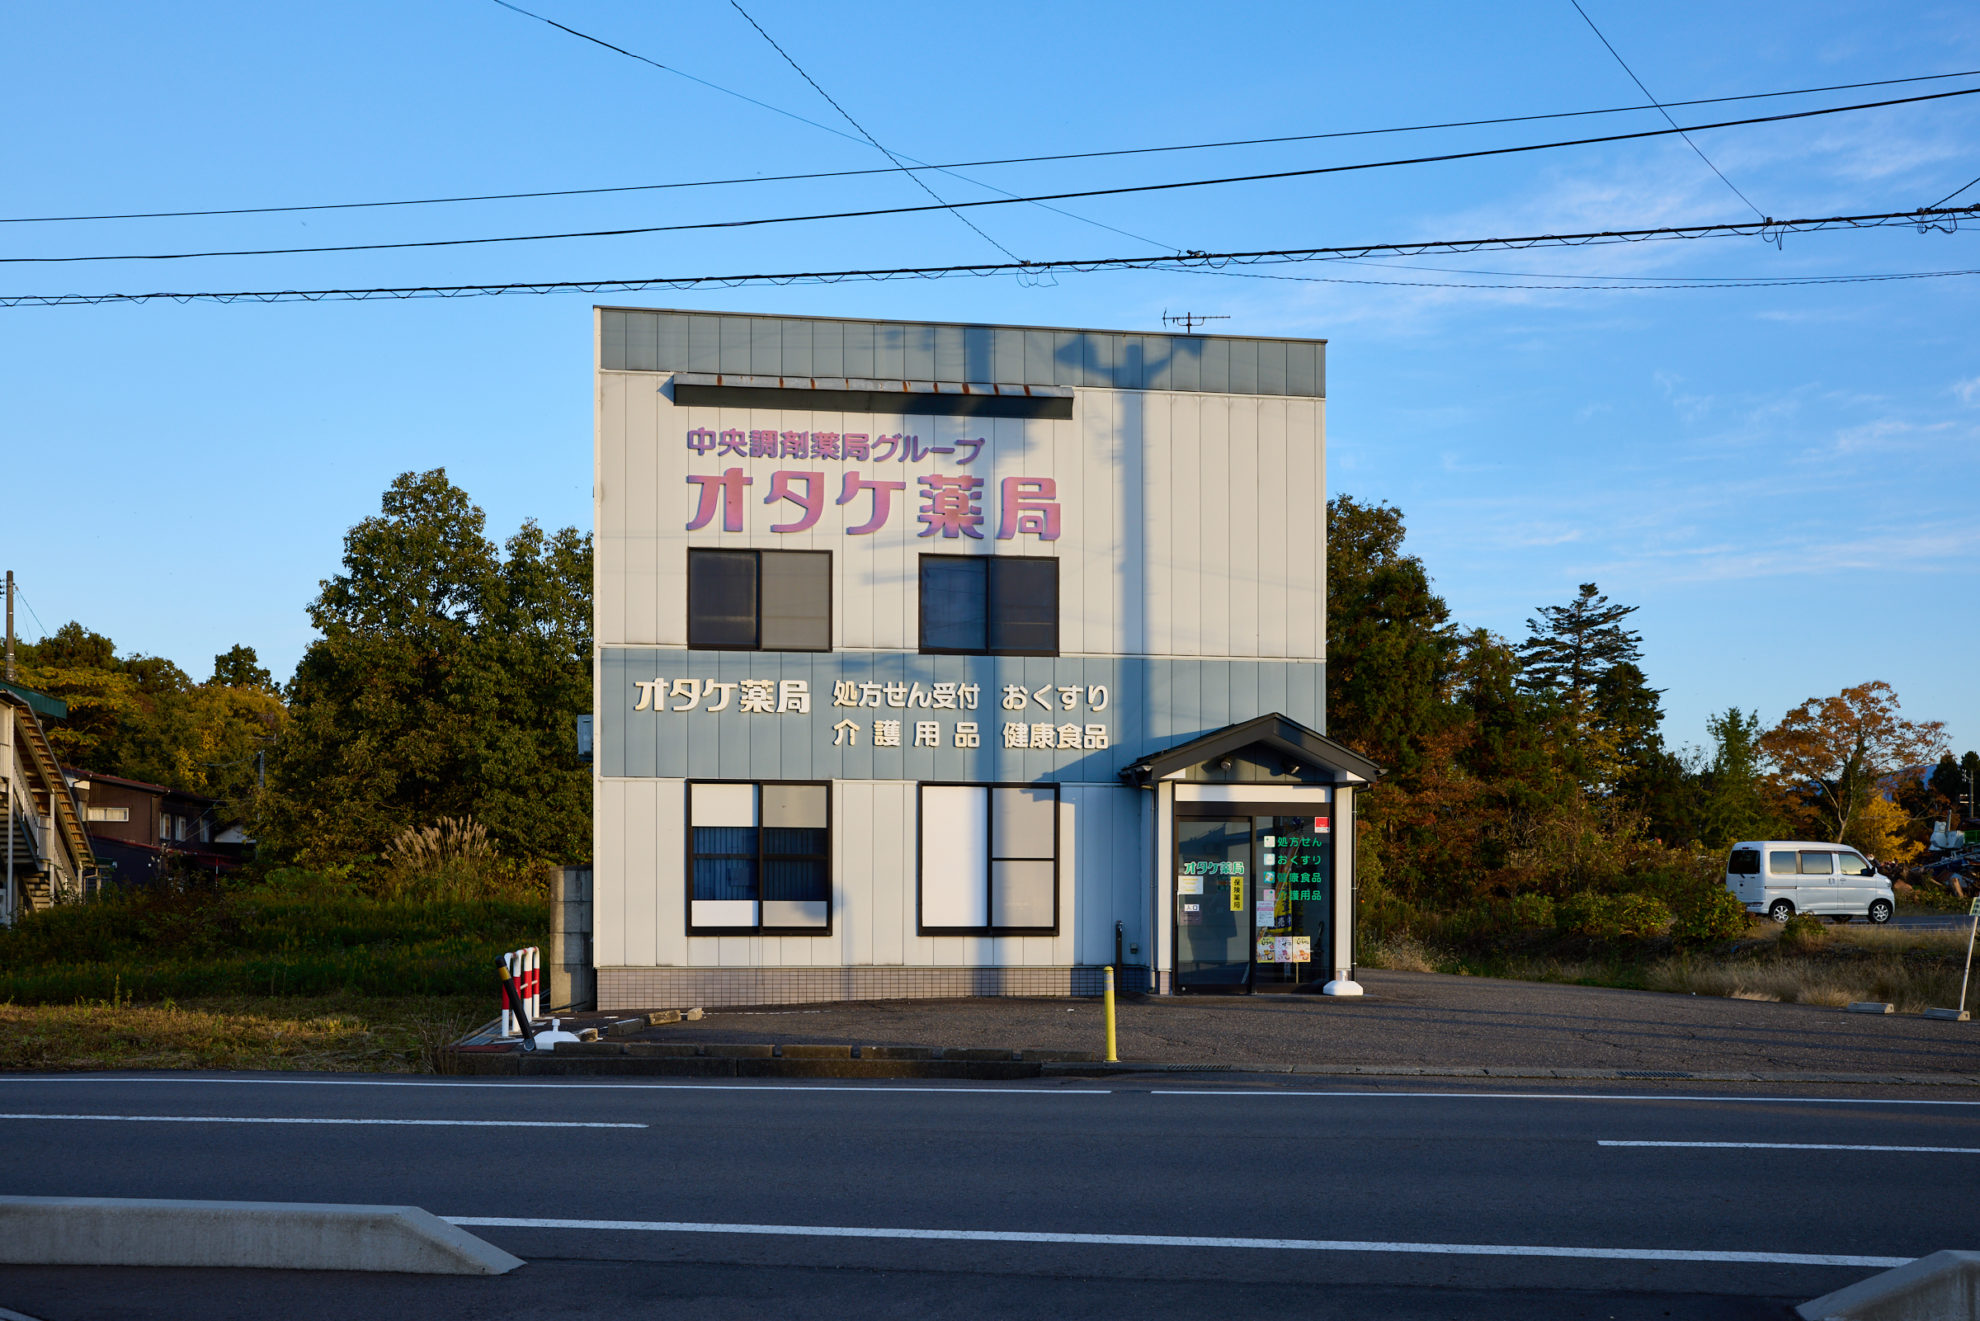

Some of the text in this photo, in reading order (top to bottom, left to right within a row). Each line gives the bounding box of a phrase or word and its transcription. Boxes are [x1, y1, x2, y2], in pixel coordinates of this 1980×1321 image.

[687, 427, 986, 465] 中央調剤薬局グループ
[686, 467, 1061, 540] オタケ薬局
[633, 677, 810, 714] オタケ薬局
[832, 680, 980, 710] 処方せん受付
[1001, 683, 1109, 712] おくすり
[832, 718, 980, 748] 介護用品
[1001, 721, 1109, 750] 健康食品
[1277, 836, 1322, 848] 処方せん
[1184, 861, 1245, 875] オタケ薬局
[1277, 854, 1322, 866] おくすり
